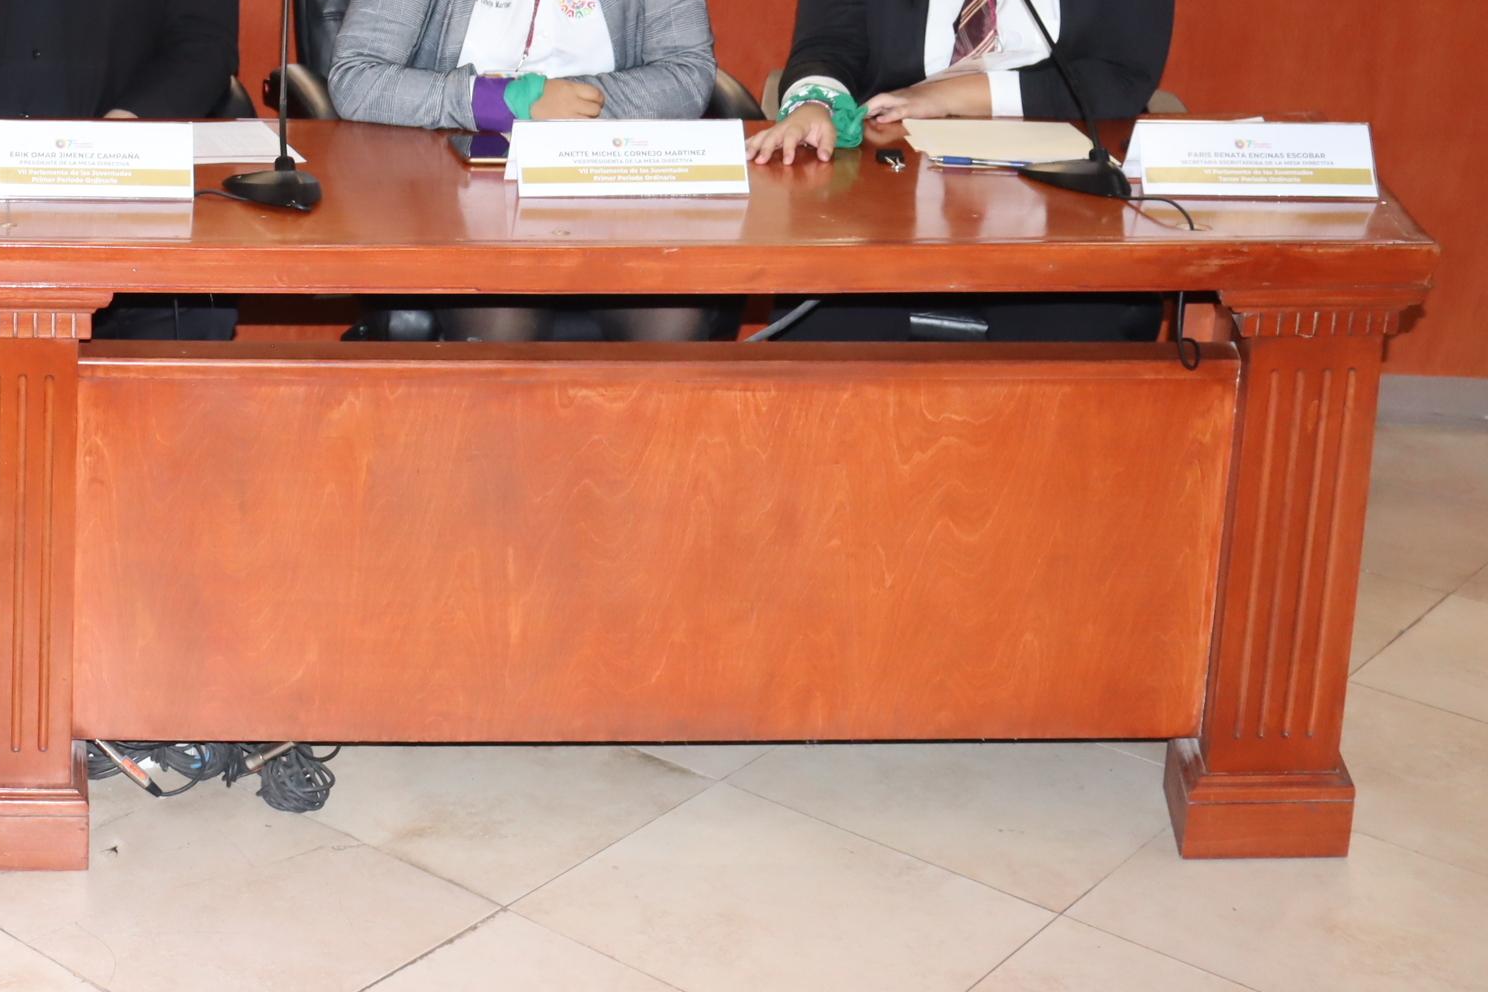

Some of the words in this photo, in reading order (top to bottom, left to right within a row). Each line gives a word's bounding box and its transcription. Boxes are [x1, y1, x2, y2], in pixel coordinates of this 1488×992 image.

[58, 151, 95, 159] JIMENEZ
[96, 151, 140, 159] CAMPAÑA
[664, 149, 706, 157] MARTINEZ
[1187, 151, 1212, 159] PARIS
[1214, 151, 1247, 159] RENATA
